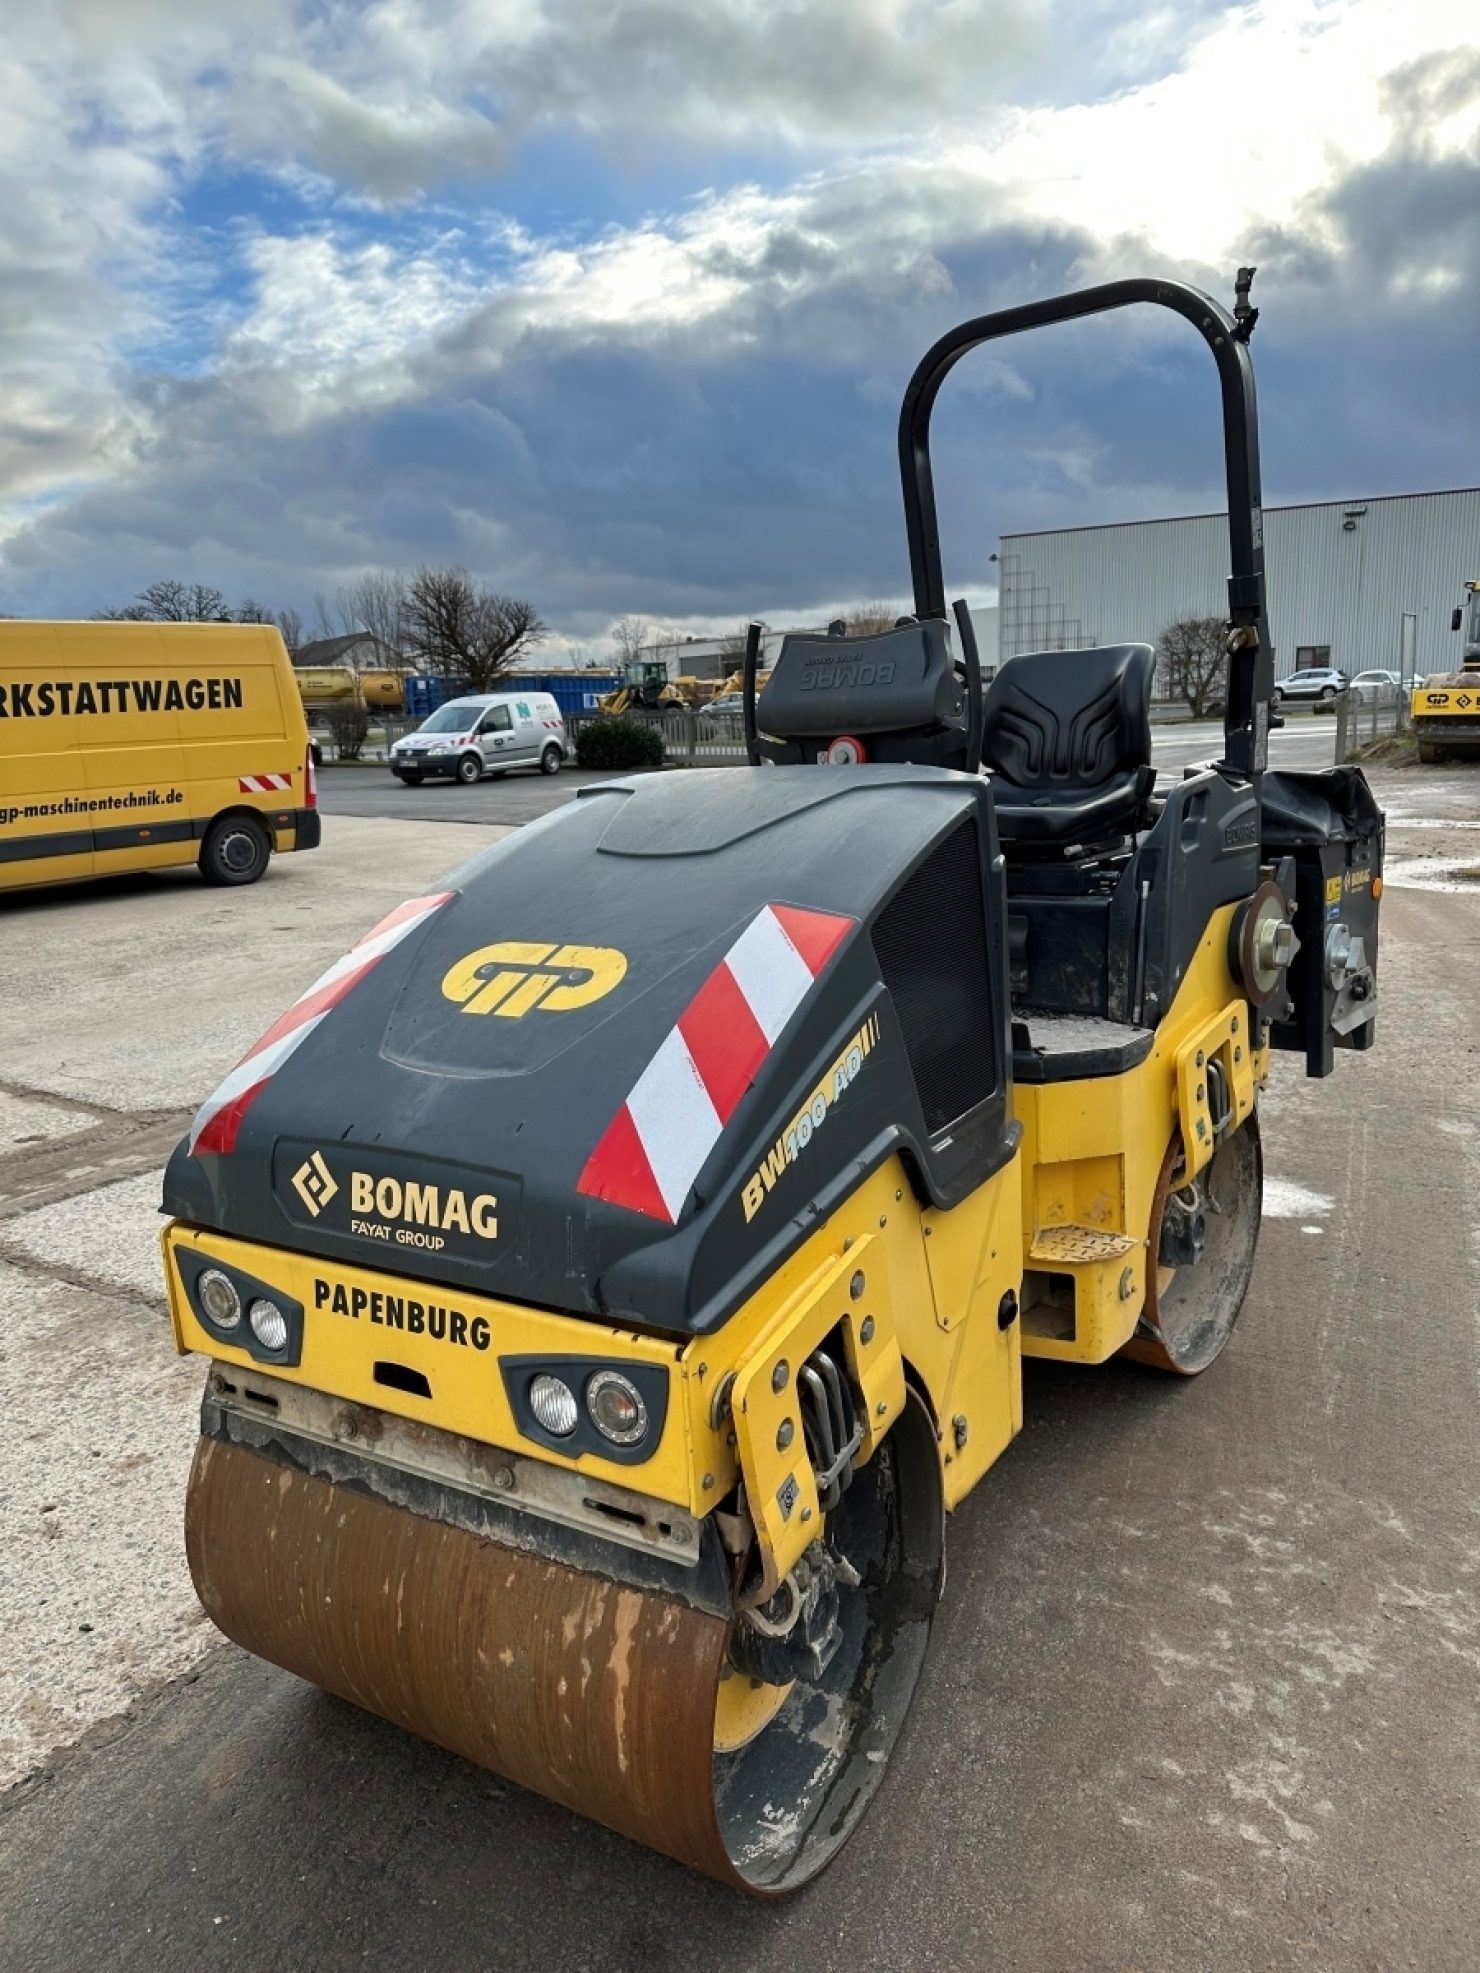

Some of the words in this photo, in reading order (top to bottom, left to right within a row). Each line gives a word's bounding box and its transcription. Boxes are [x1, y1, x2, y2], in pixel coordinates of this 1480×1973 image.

[801, 663, 895, 690] BOMAG
[0, 789, 183, 824] gp-maschinentechnik.de
[351, 1171, 497, 1239] BOMAG
[351, 1219, 391, 1241] FAYAT
[396, 1229, 445, 1250] GROUP
[314, 1278, 490, 1351] PAPENBURG
